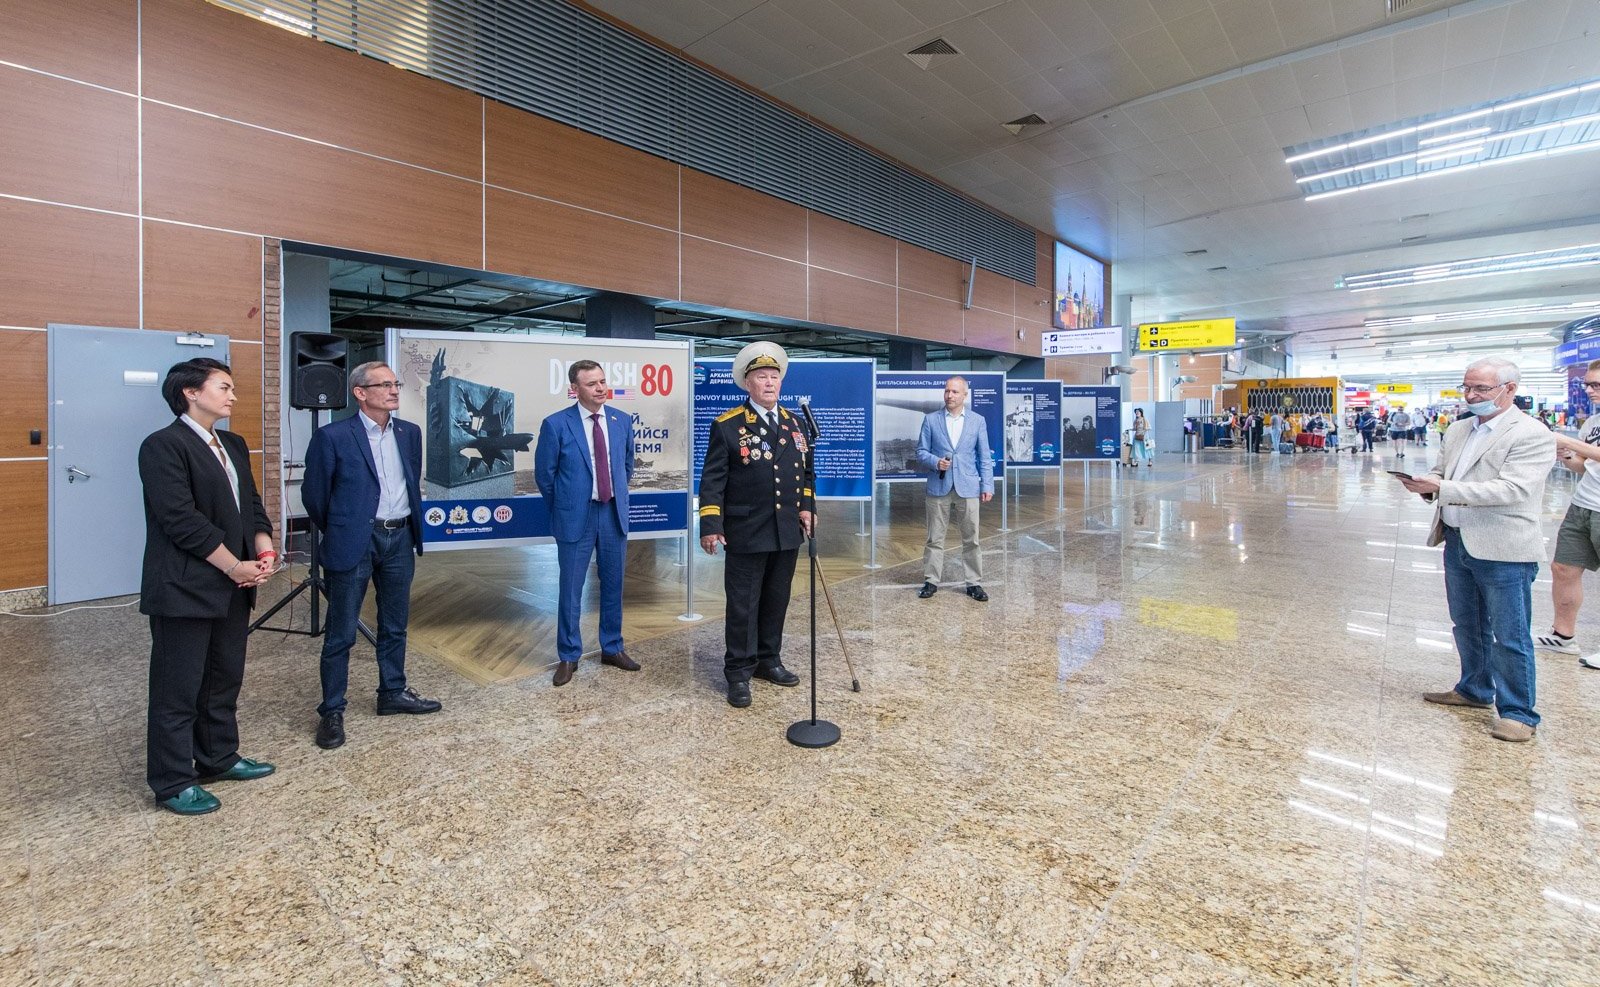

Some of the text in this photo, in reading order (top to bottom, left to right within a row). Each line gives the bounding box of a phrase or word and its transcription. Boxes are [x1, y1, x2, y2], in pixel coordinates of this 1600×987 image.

[640, 363, 673, 397] 80
[631, 412, 644, 426] Й,
[632, 426, 668, 439] ИЙСЯ
[635, 443, 662, 453] ЕМЯ
